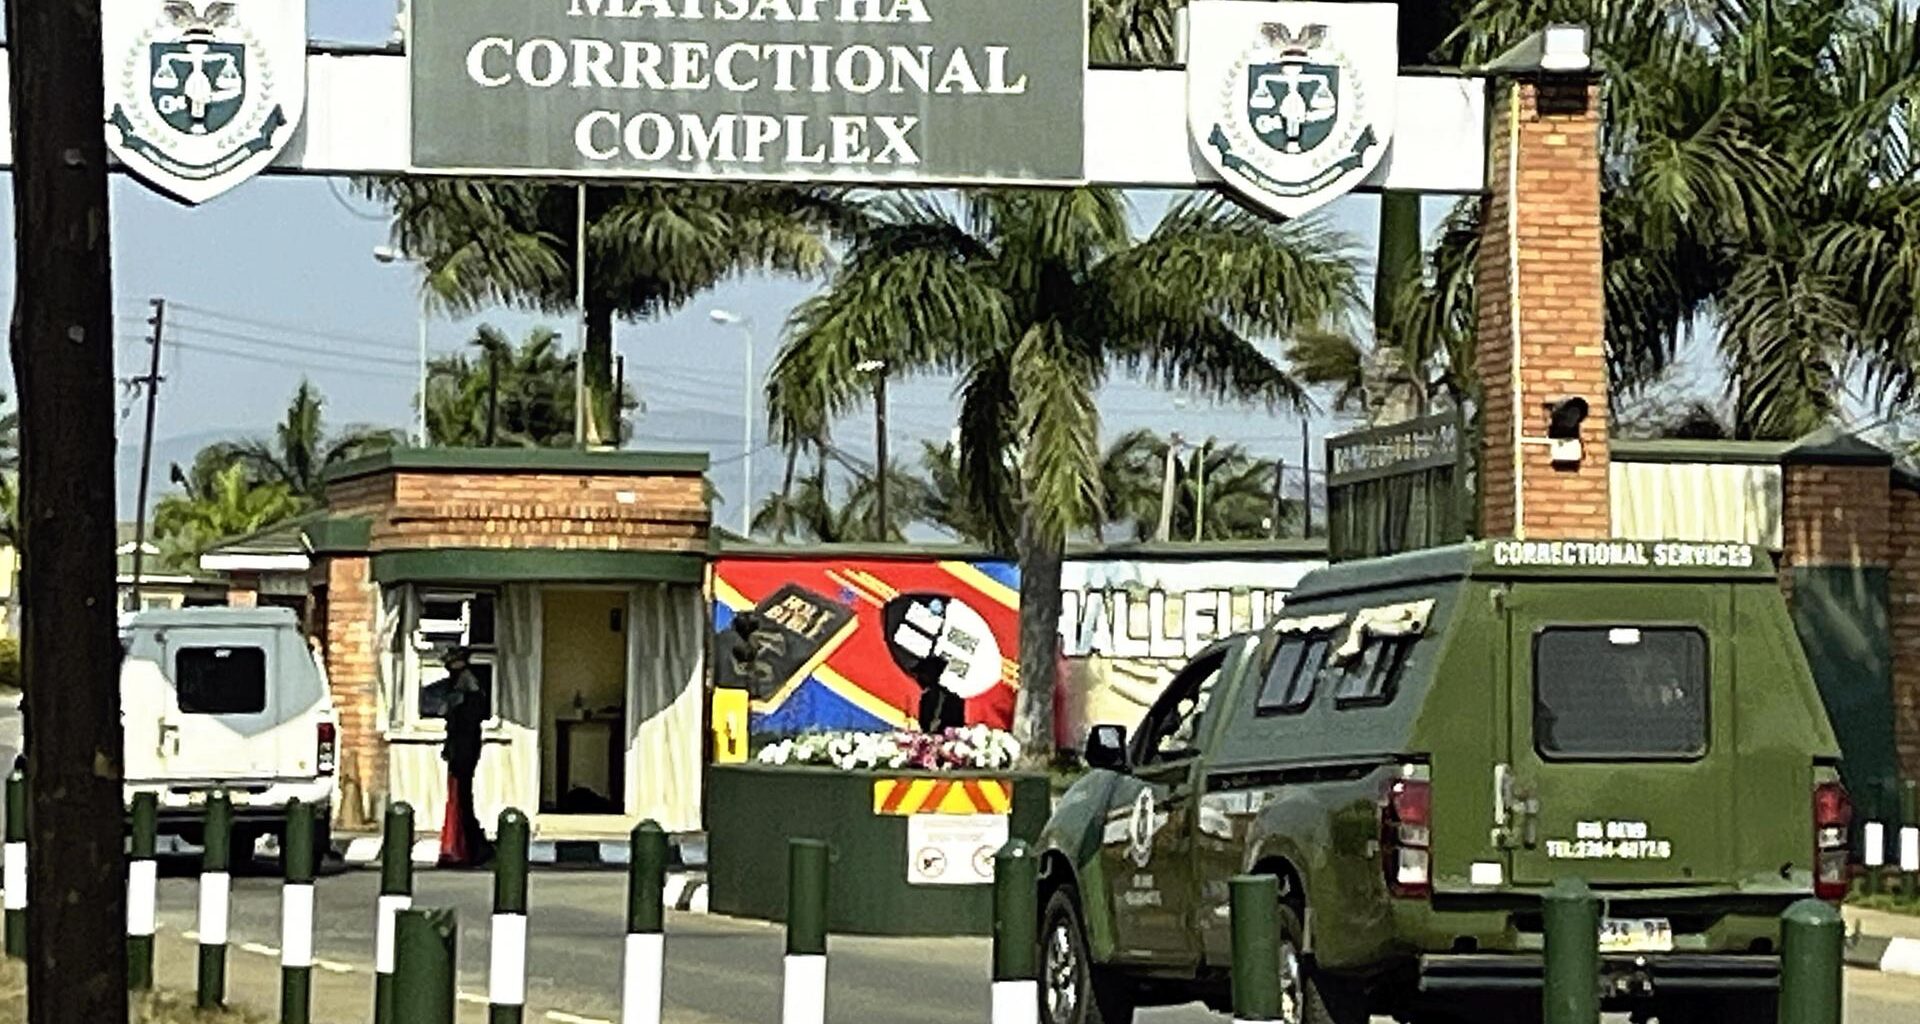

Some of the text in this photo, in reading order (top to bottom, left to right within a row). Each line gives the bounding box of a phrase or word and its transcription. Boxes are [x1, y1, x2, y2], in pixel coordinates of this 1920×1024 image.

[466, 37, 1027, 95] CORRECTIONAL
[574, 110, 921, 164] COMPLEX
[1494, 541, 1753, 567] CORRECTIONAL SERVICES
